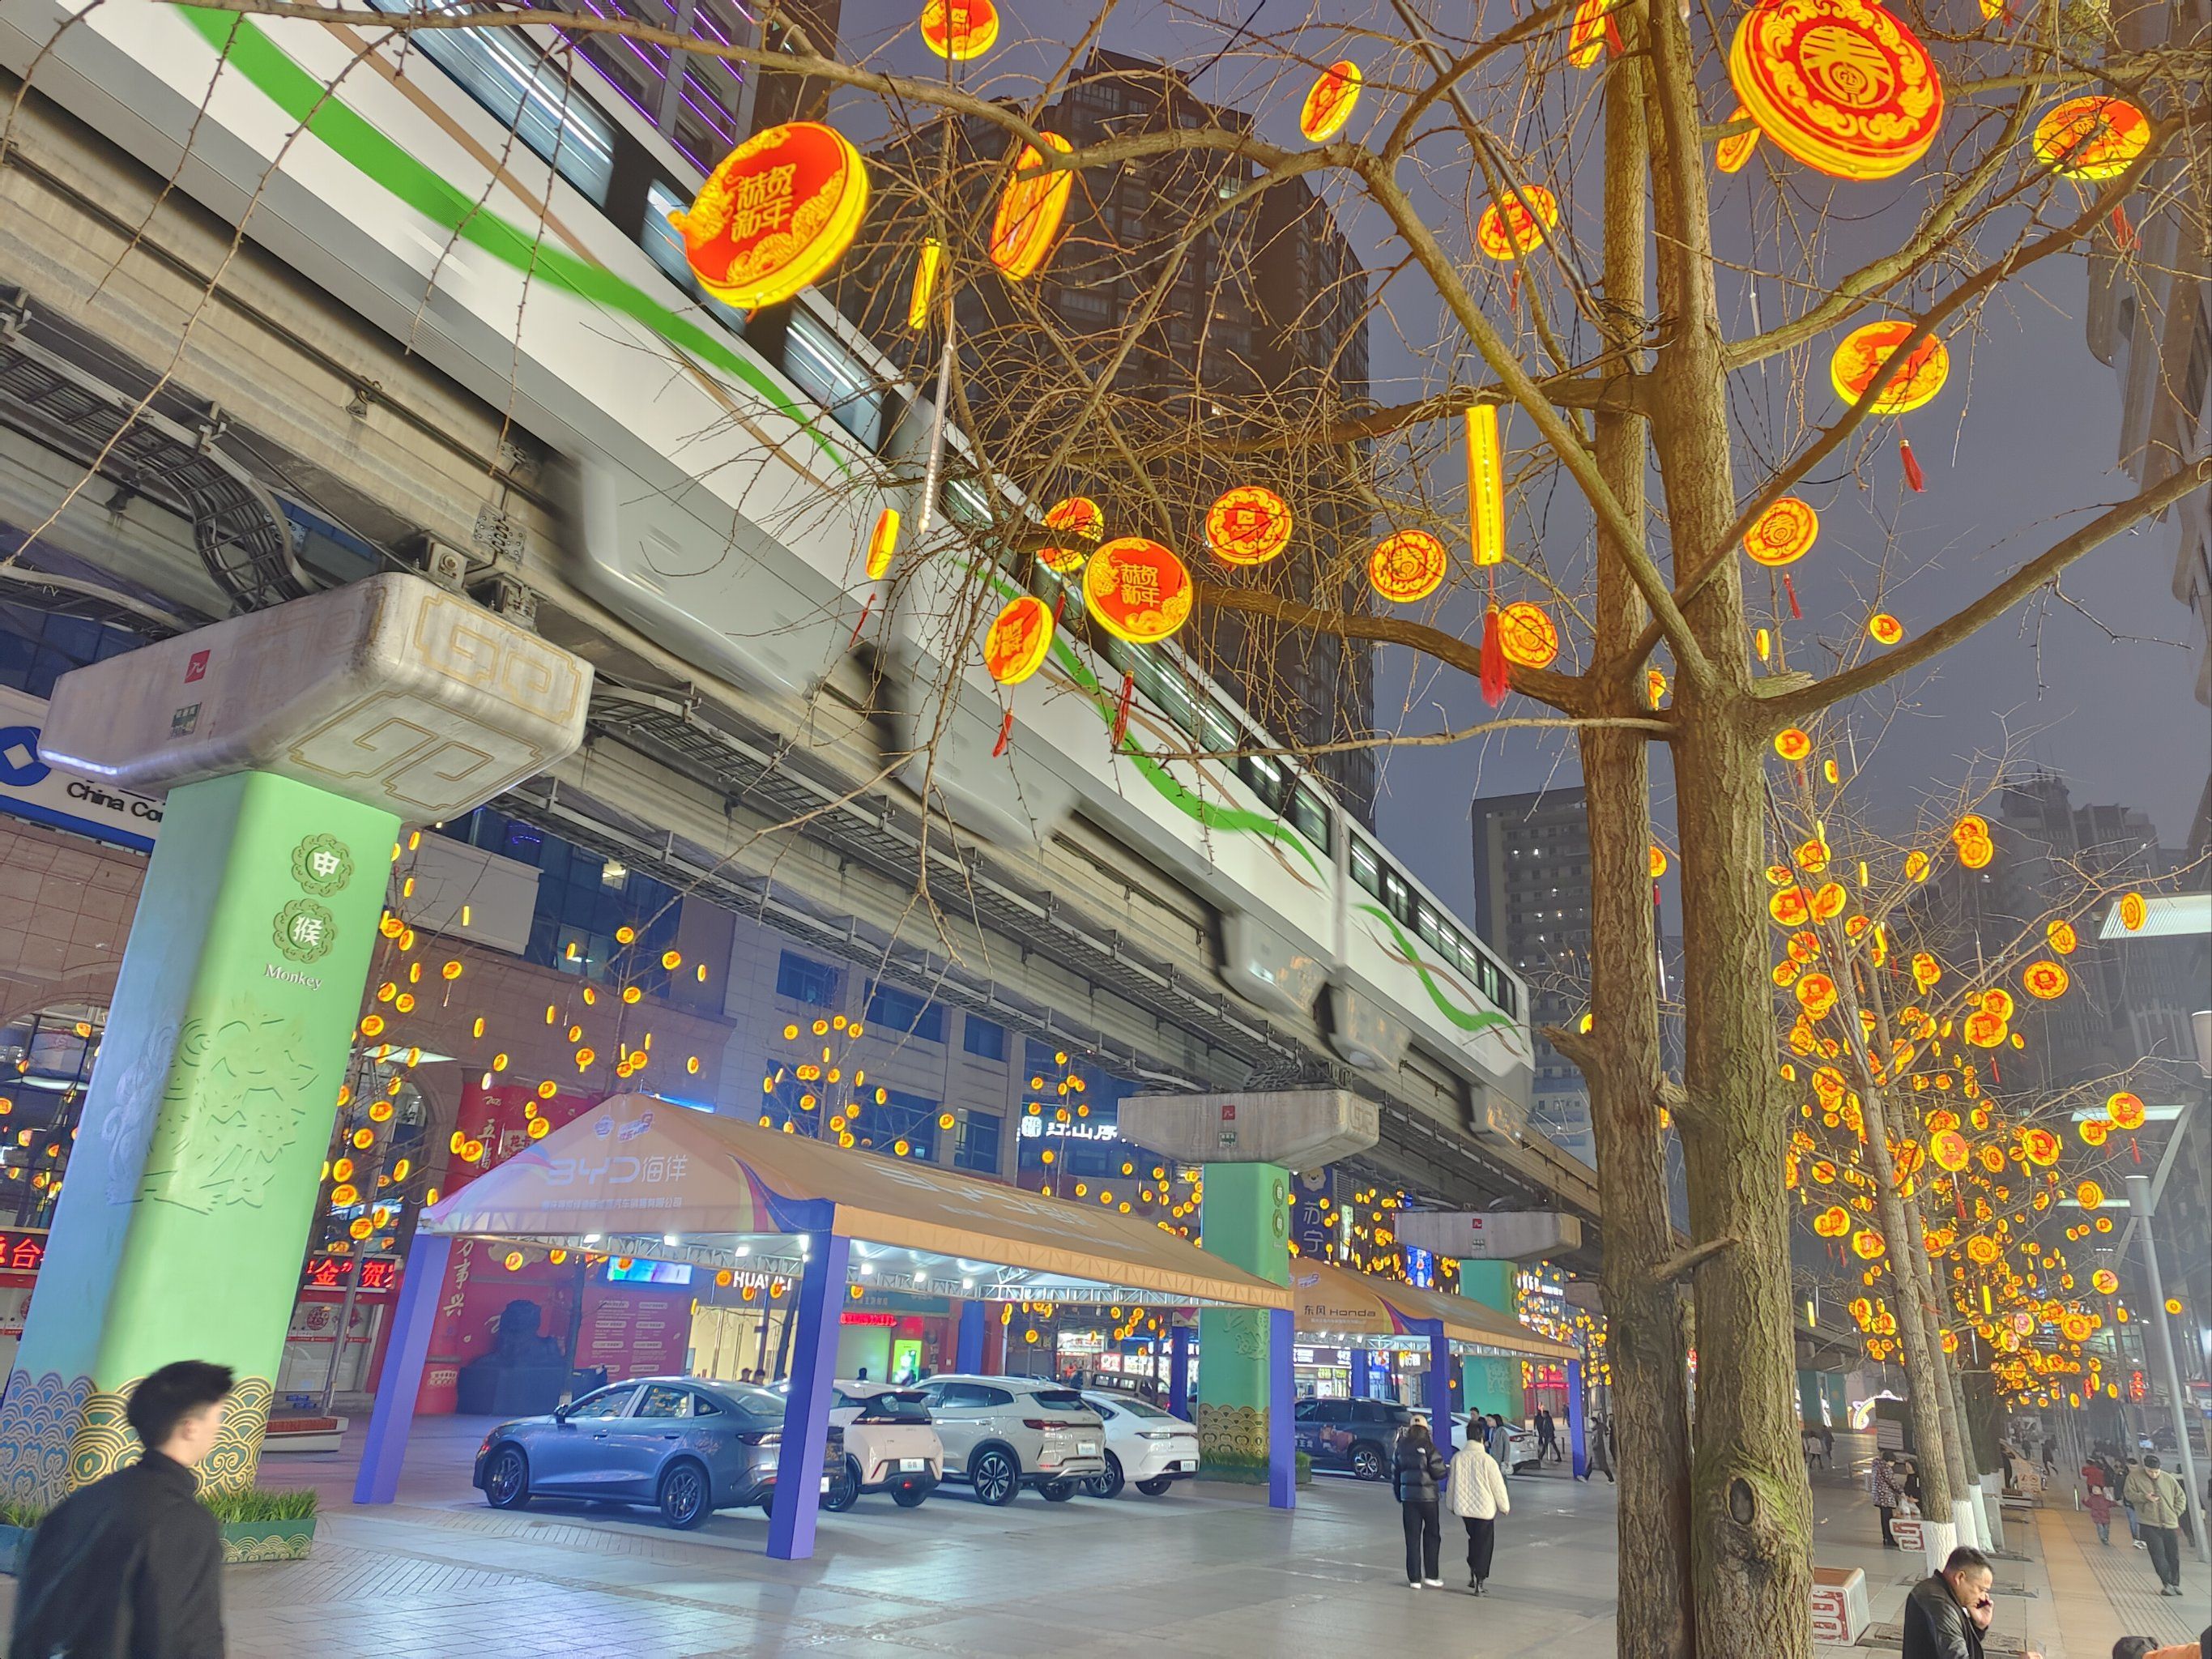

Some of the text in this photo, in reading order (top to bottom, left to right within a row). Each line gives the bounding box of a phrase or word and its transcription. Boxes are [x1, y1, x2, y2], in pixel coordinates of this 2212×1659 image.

[66, 782, 124, 812] China
[313, 851, 341, 877] 申
[292, 916, 323, 947] 猴
[265, 964, 322, 991] Monkey
[1302, 1200, 1325, 1252] 苏宁
[442, 1237, 475, 1317] 万事兴
[1304, 1304, 1376, 1318] 东风 Honda
